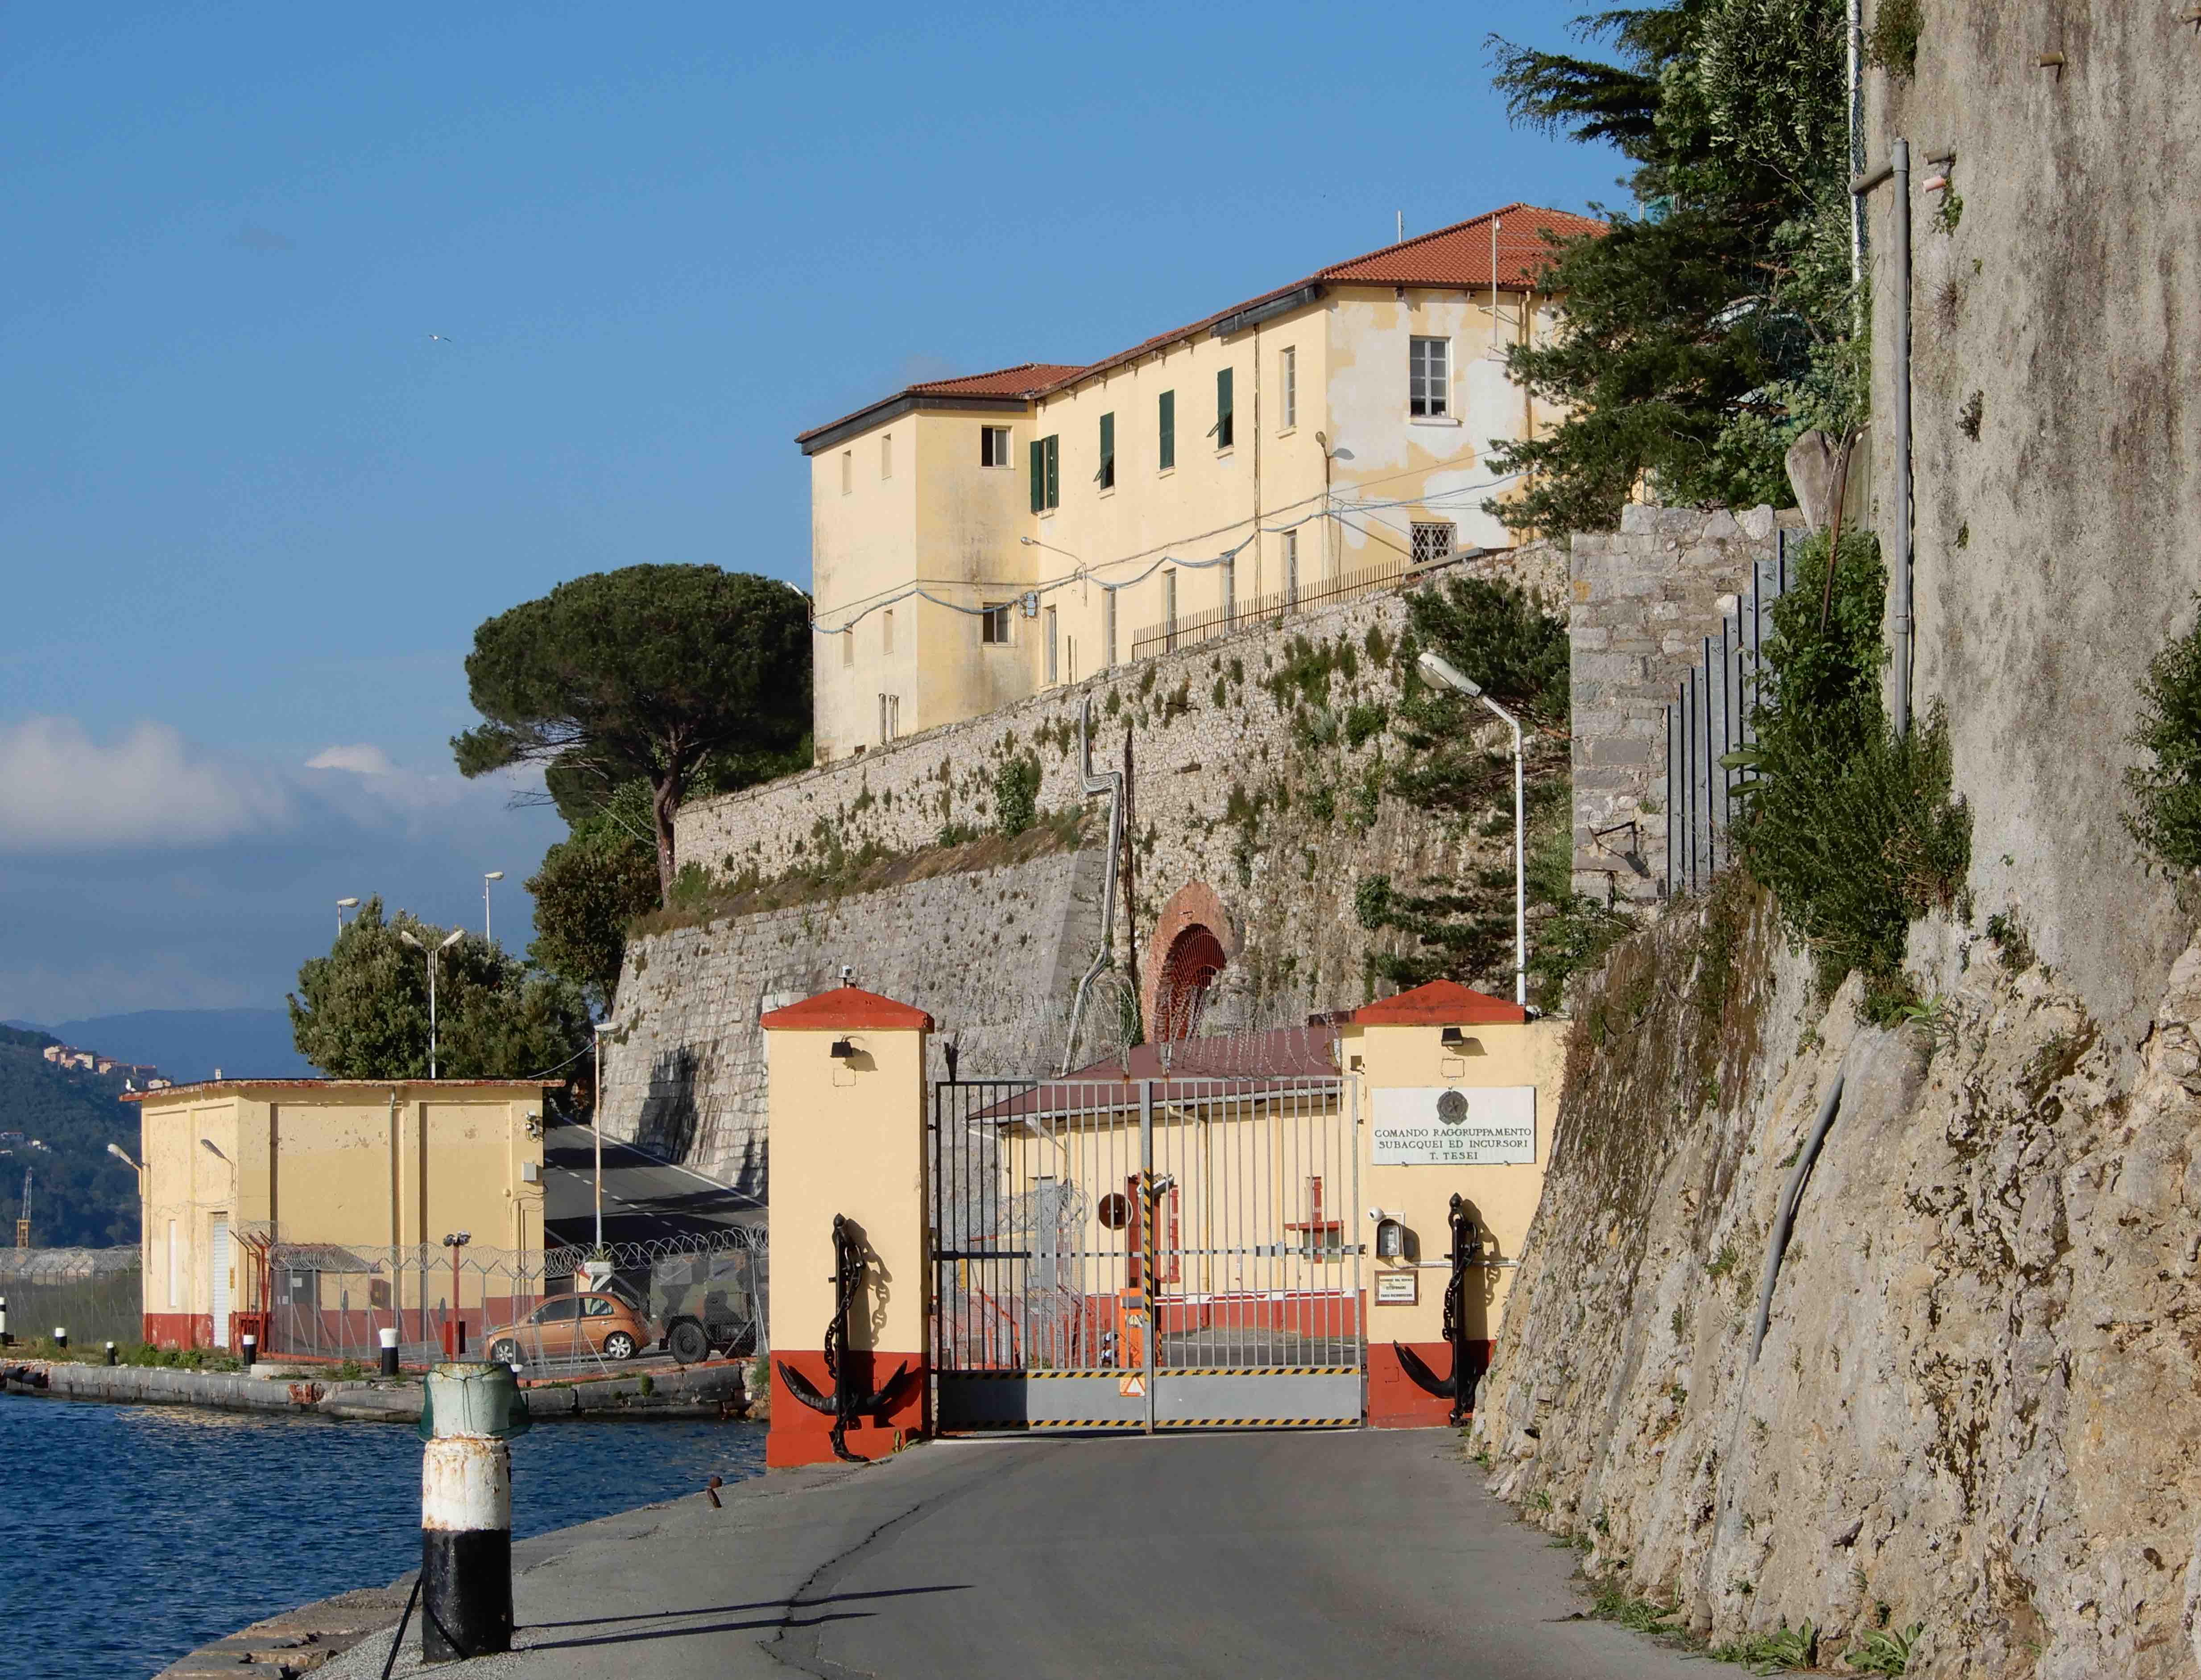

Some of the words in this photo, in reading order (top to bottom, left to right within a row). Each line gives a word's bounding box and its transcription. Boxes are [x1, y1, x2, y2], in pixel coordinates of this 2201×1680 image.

[1374, 1129, 1428, 1137] COMANDO
[1433, 1128, 1531, 1137] RAGGRUPPAMENTO
[1379, 1140, 1443, 1149] SUBACQUEI
[1448, 1140, 1463, 1148] ED
[1469, 1139, 1527, 1148] INCURSORI
[1429, 1152, 1439, 1160] T.
[1443, 1152, 1477, 1160] TESEI
